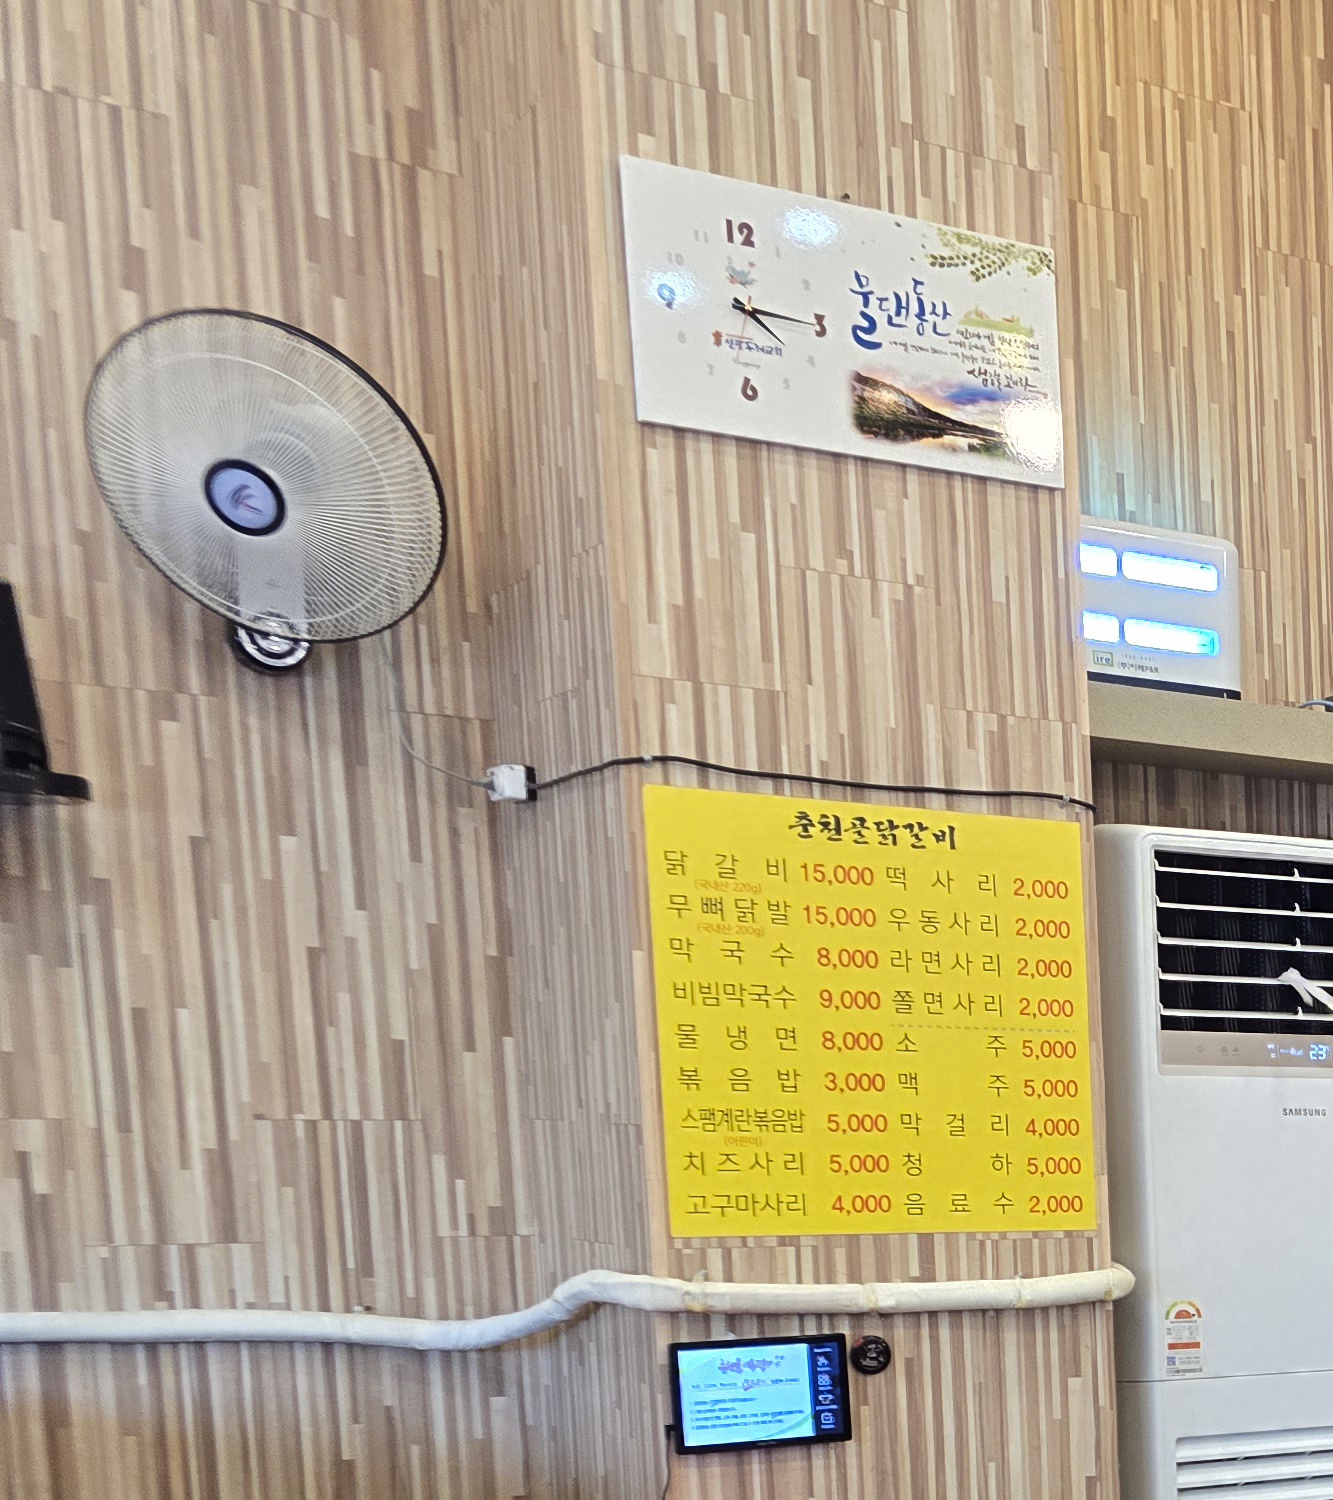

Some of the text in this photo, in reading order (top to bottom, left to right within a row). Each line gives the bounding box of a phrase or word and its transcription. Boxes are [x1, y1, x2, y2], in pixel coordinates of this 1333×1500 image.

[725, 218, 755, 248] 12
[657, 284, 675, 310] 9
[814, 313, 826, 337] 3
[741, 376, 758, 400] 6
[788, 811, 956, 850] 춘천골닭갈비
[801, 863, 874, 886] 15,000
[1013, 878, 1069, 899] 2,000
[803, 905, 877, 928] 15,000
[1015, 918, 1070, 939] 2,000
[817, 947, 879, 970] 8,000
[1017, 958, 1072, 979] 2,000
[672, 981, 797, 1010] 비빔막국수
[819, 989, 881, 1011] 9,000
[1019, 997, 1074, 1019] 2,000
[822, 1031, 883, 1052] 8,000
[1022, 1040, 1076, 1060] 5,000
[825, 1072, 885, 1094] 3,000
[1024, 1079, 1078, 1099] 5,000
[680, 1107, 805, 1134] 스팸계란볶음밥
[828, 1114, 888, 1134] 5,000
[1025, 1118, 1080, 1138] 4,000
[1282, 1107, 1327, 1117] SAMSUNG
[830, 1154, 890, 1175] 5,000
[1027, 1157, 1081, 1177] 5,000
[685, 1194, 806, 1218] 고구마사리
[832, 1195, 891, 1215] 4,000
[1029, 1195, 1083, 1215] 2,000
